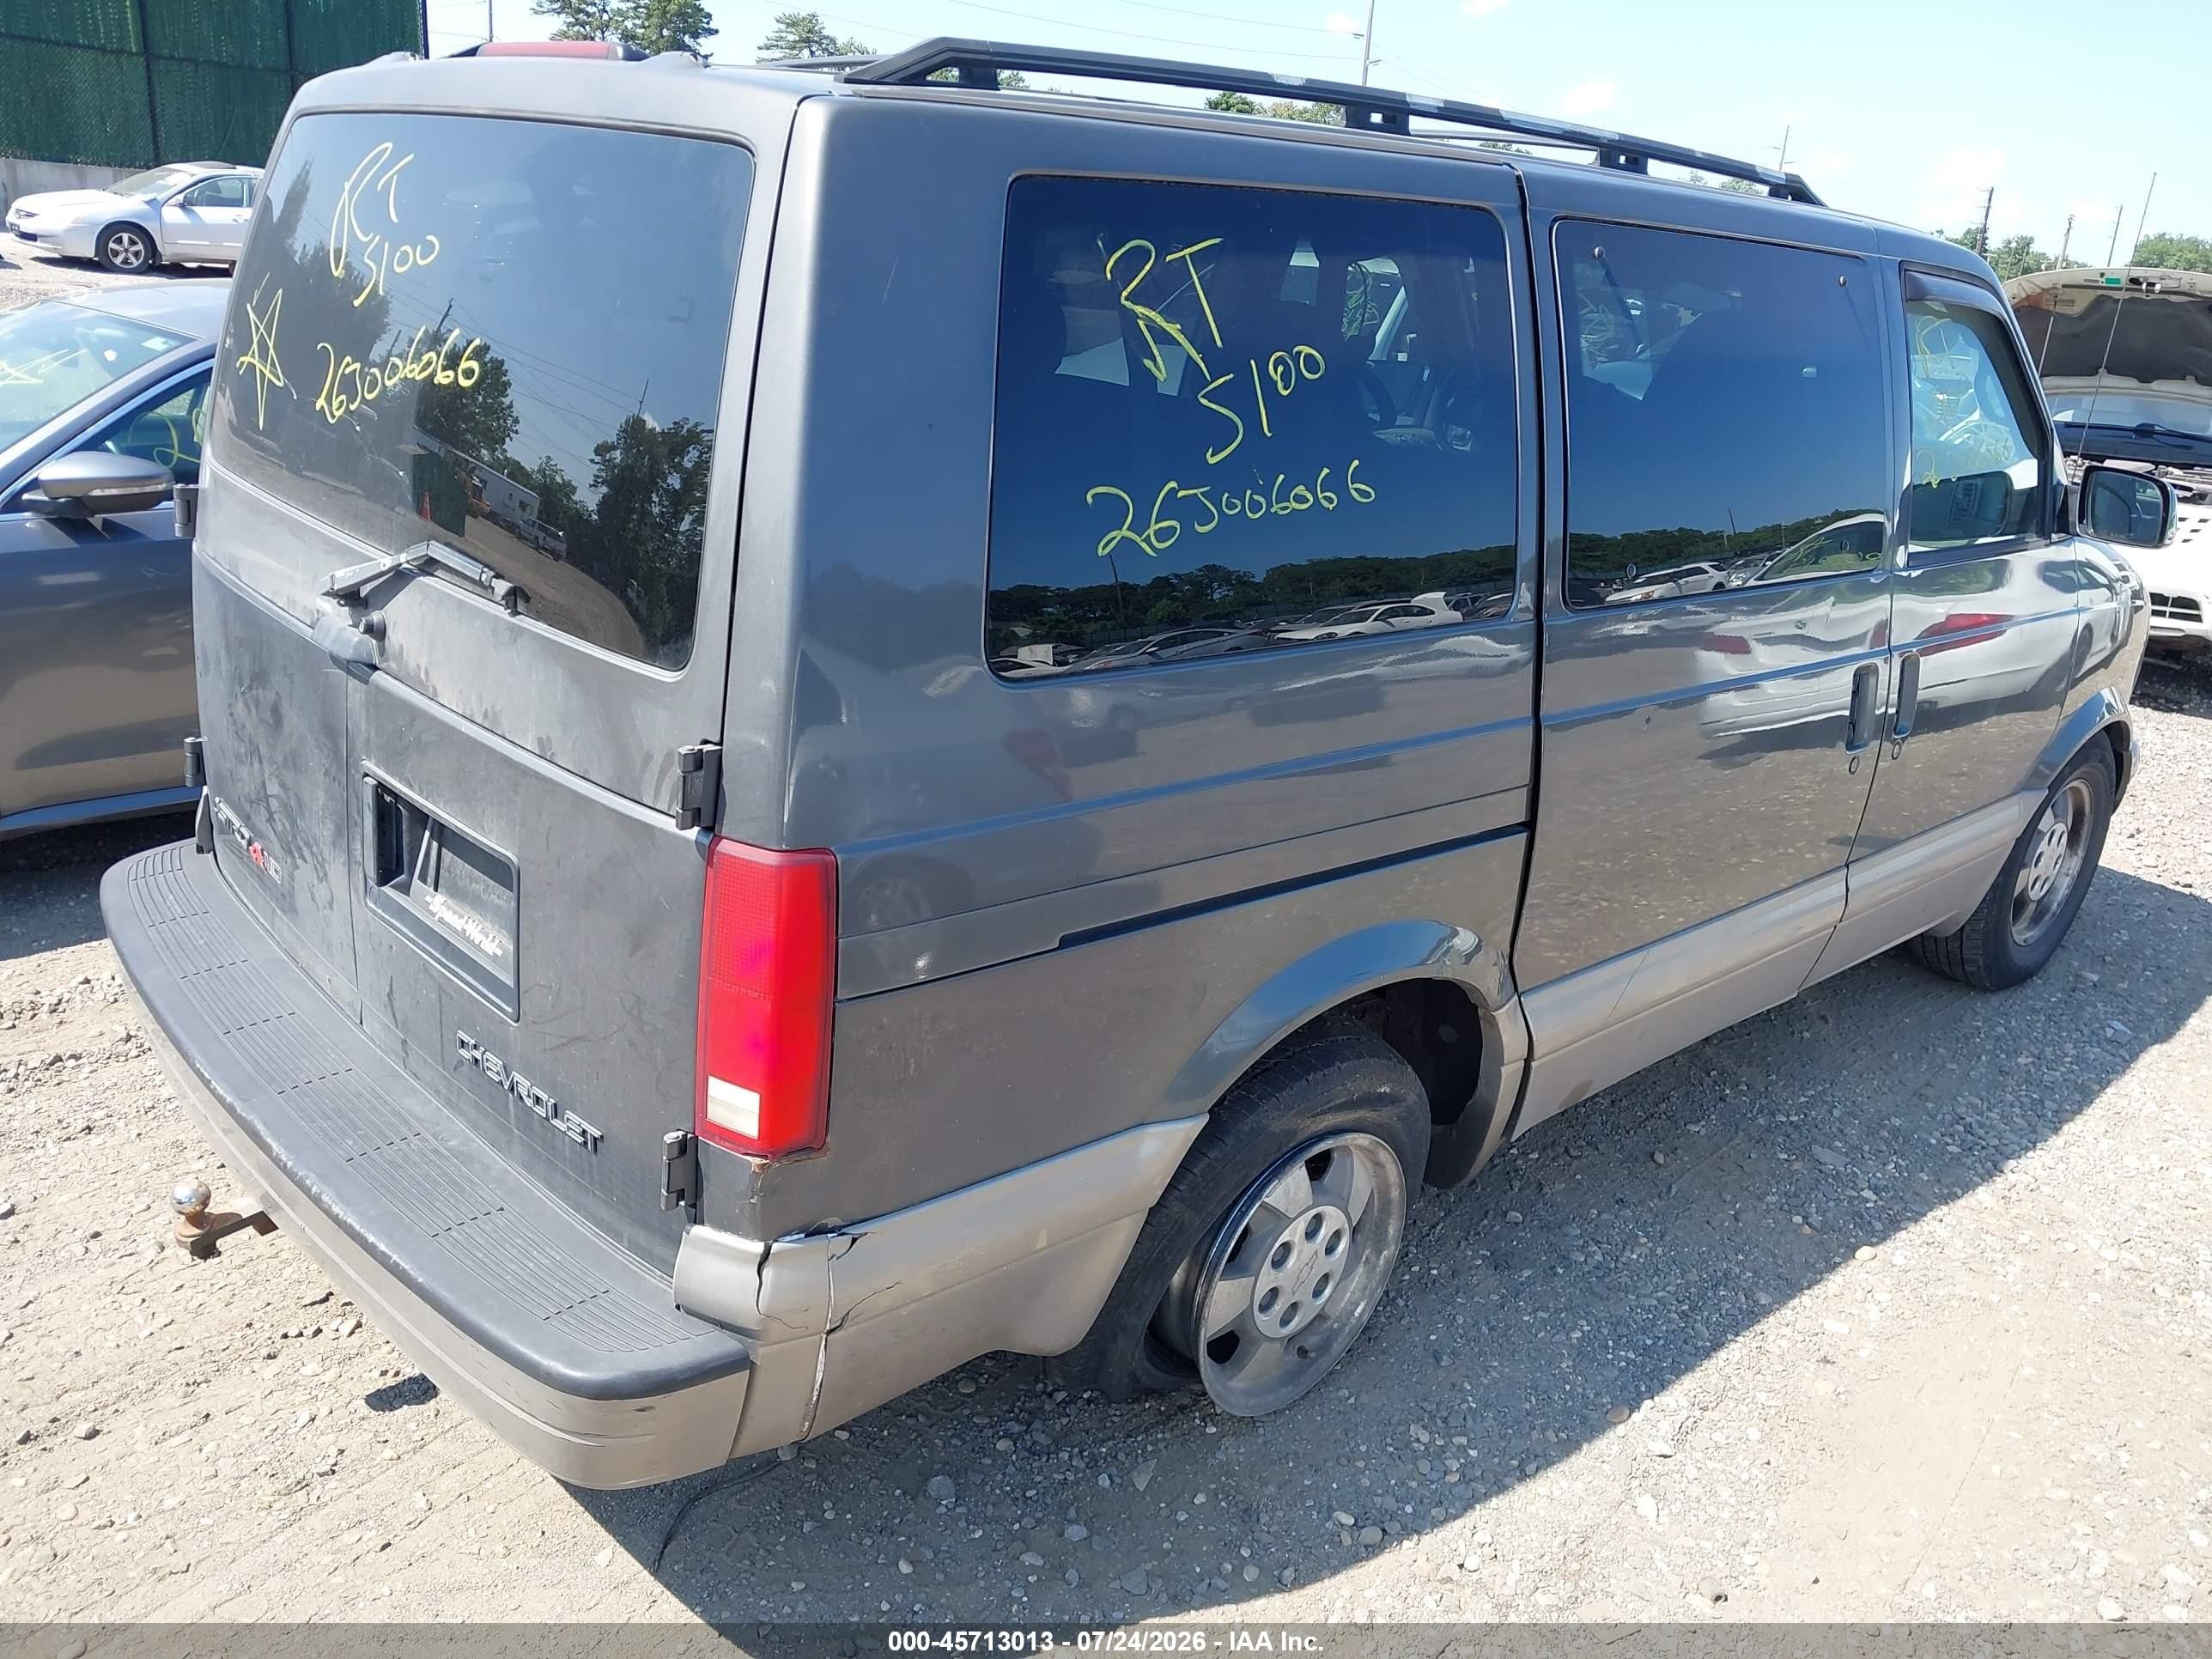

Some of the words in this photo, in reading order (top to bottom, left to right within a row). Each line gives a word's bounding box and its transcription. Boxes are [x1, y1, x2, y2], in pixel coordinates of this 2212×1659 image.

[353, 234, 440, 307] 5100
[1106, 237, 1224, 383] RT
[1197, 344, 1326, 465] 5100
[457, 1030, 604, 1156] CHEVROLET
